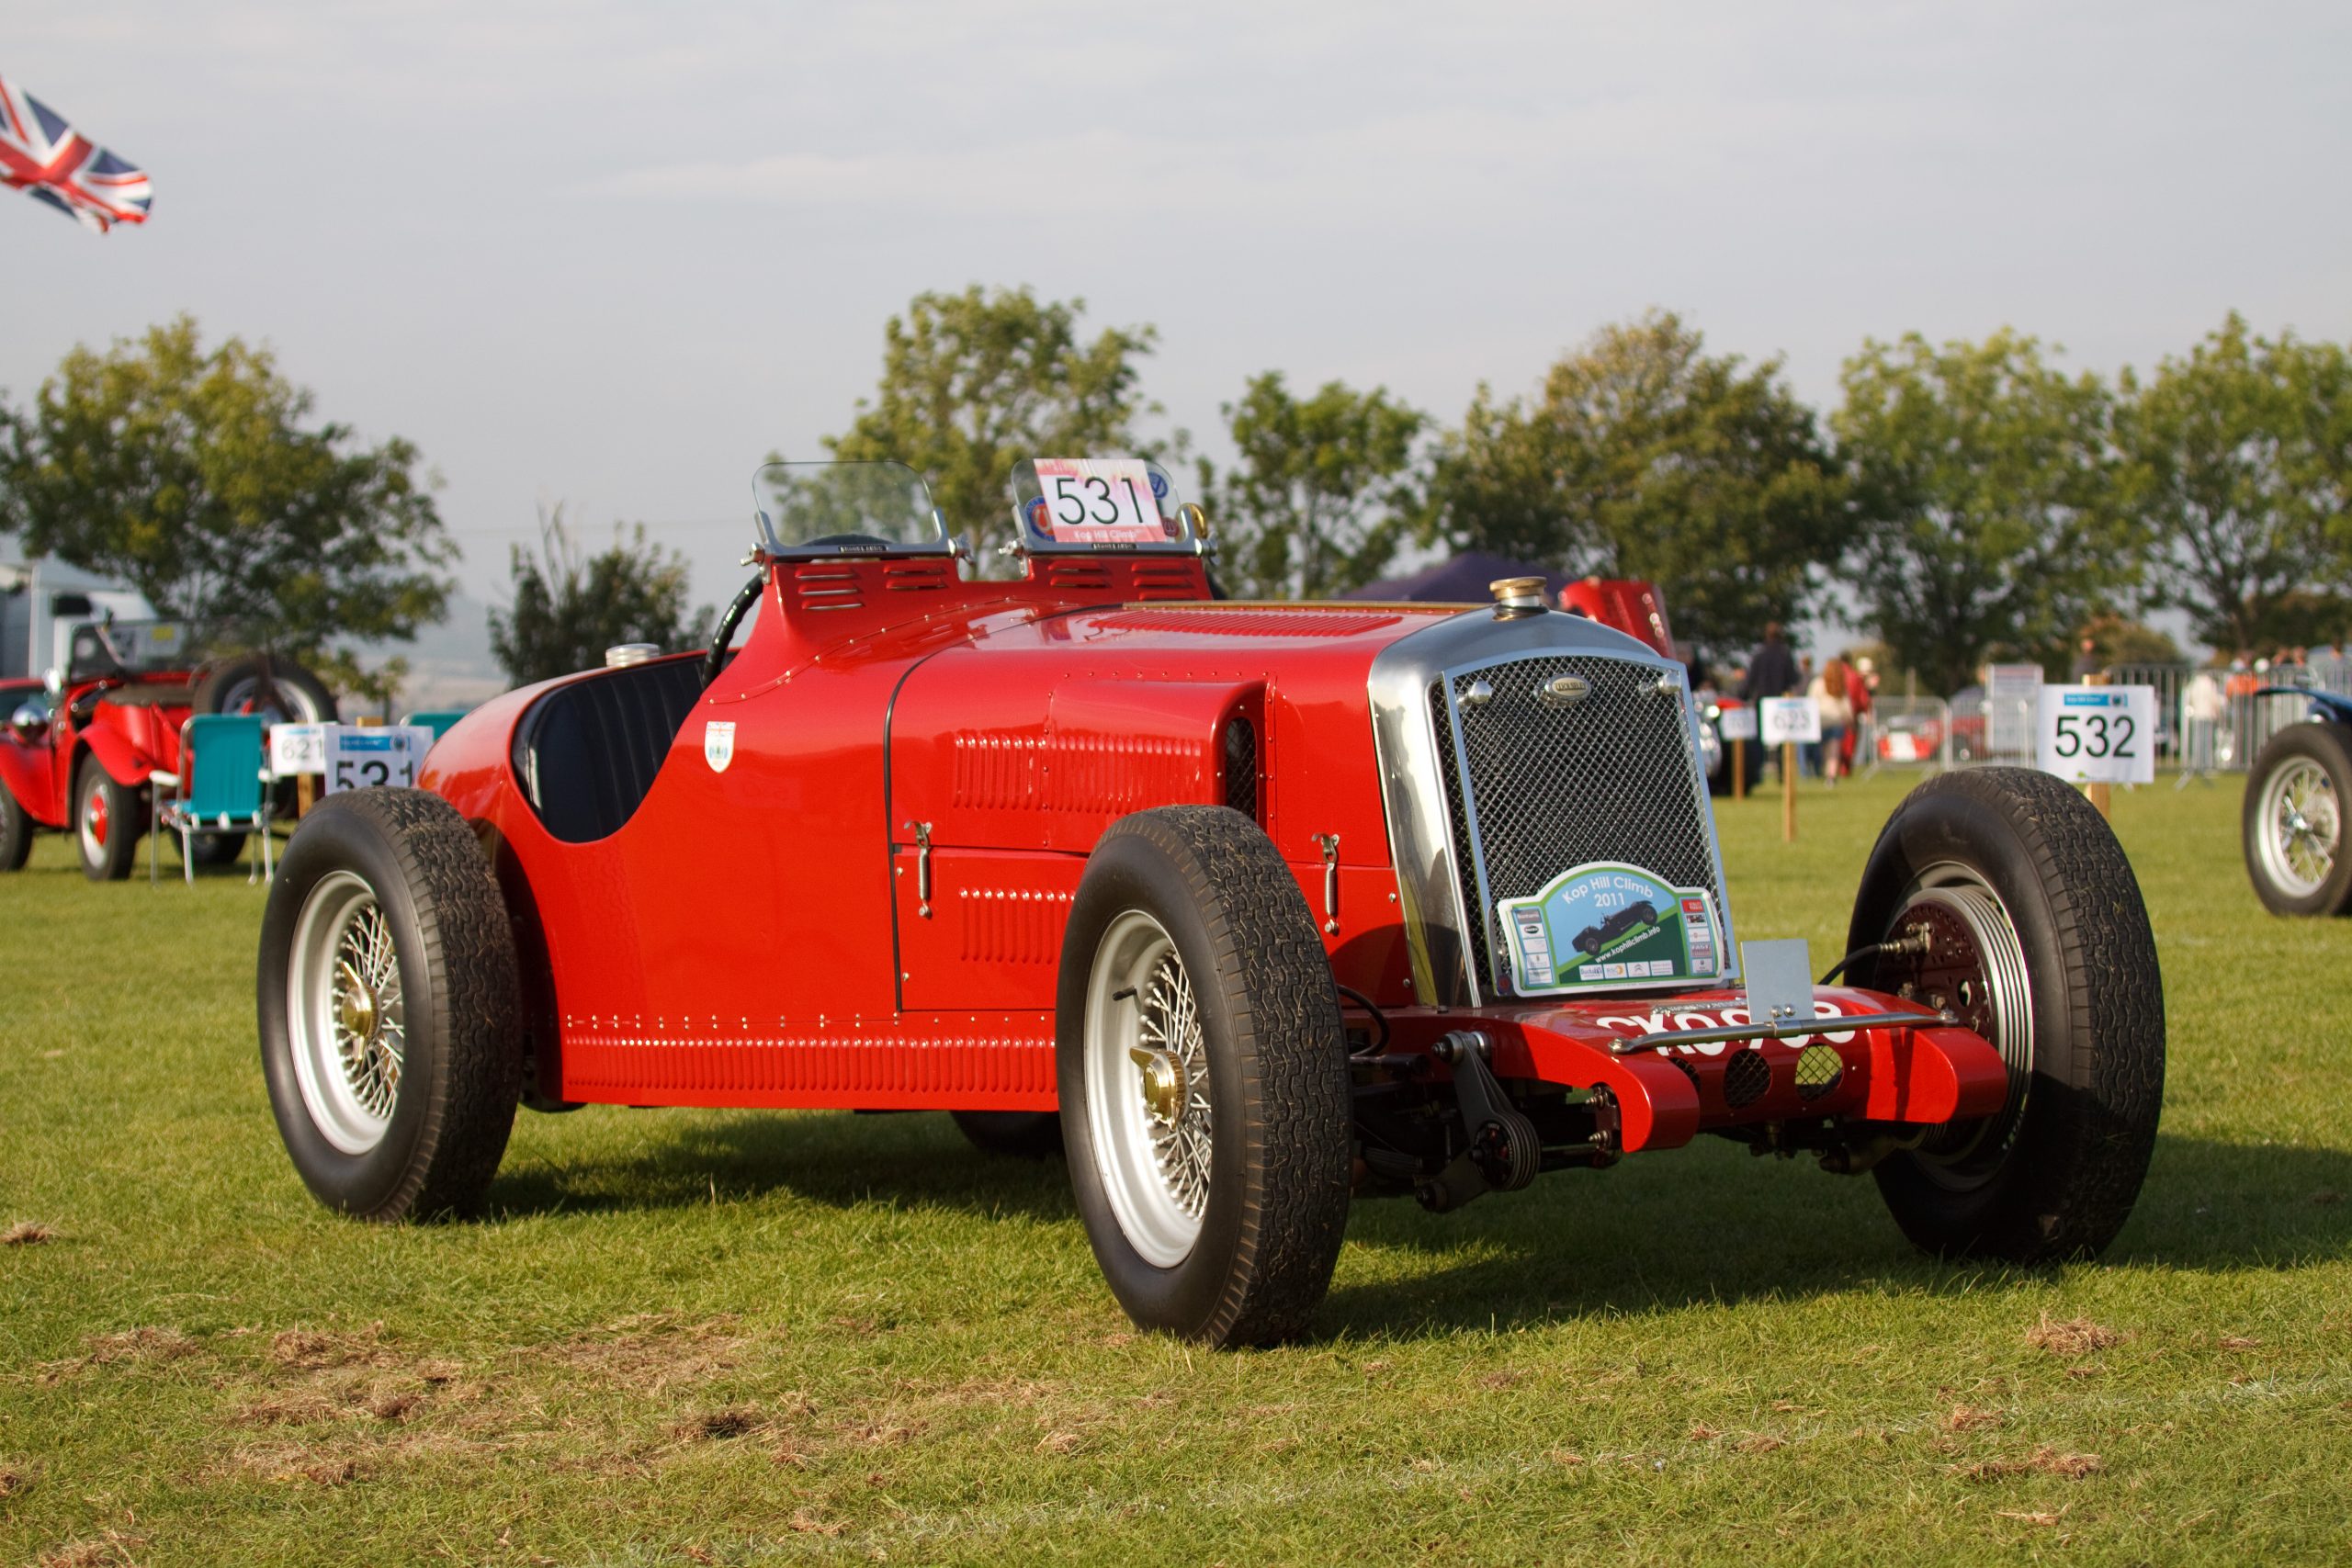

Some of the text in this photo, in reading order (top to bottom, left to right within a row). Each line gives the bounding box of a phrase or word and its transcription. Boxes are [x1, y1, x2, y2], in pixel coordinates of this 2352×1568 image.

[1056, 476, 1144, 525] 531
[1110, 529, 1136, 540] Climb
[2055, 715, 2135, 758] 532
[1563, 876, 1654, 904] Kop Hill Climb
[1594, 892, 1625, 908] 2011
[1595, 925, 1661, 964] www.kophillclimb.info
